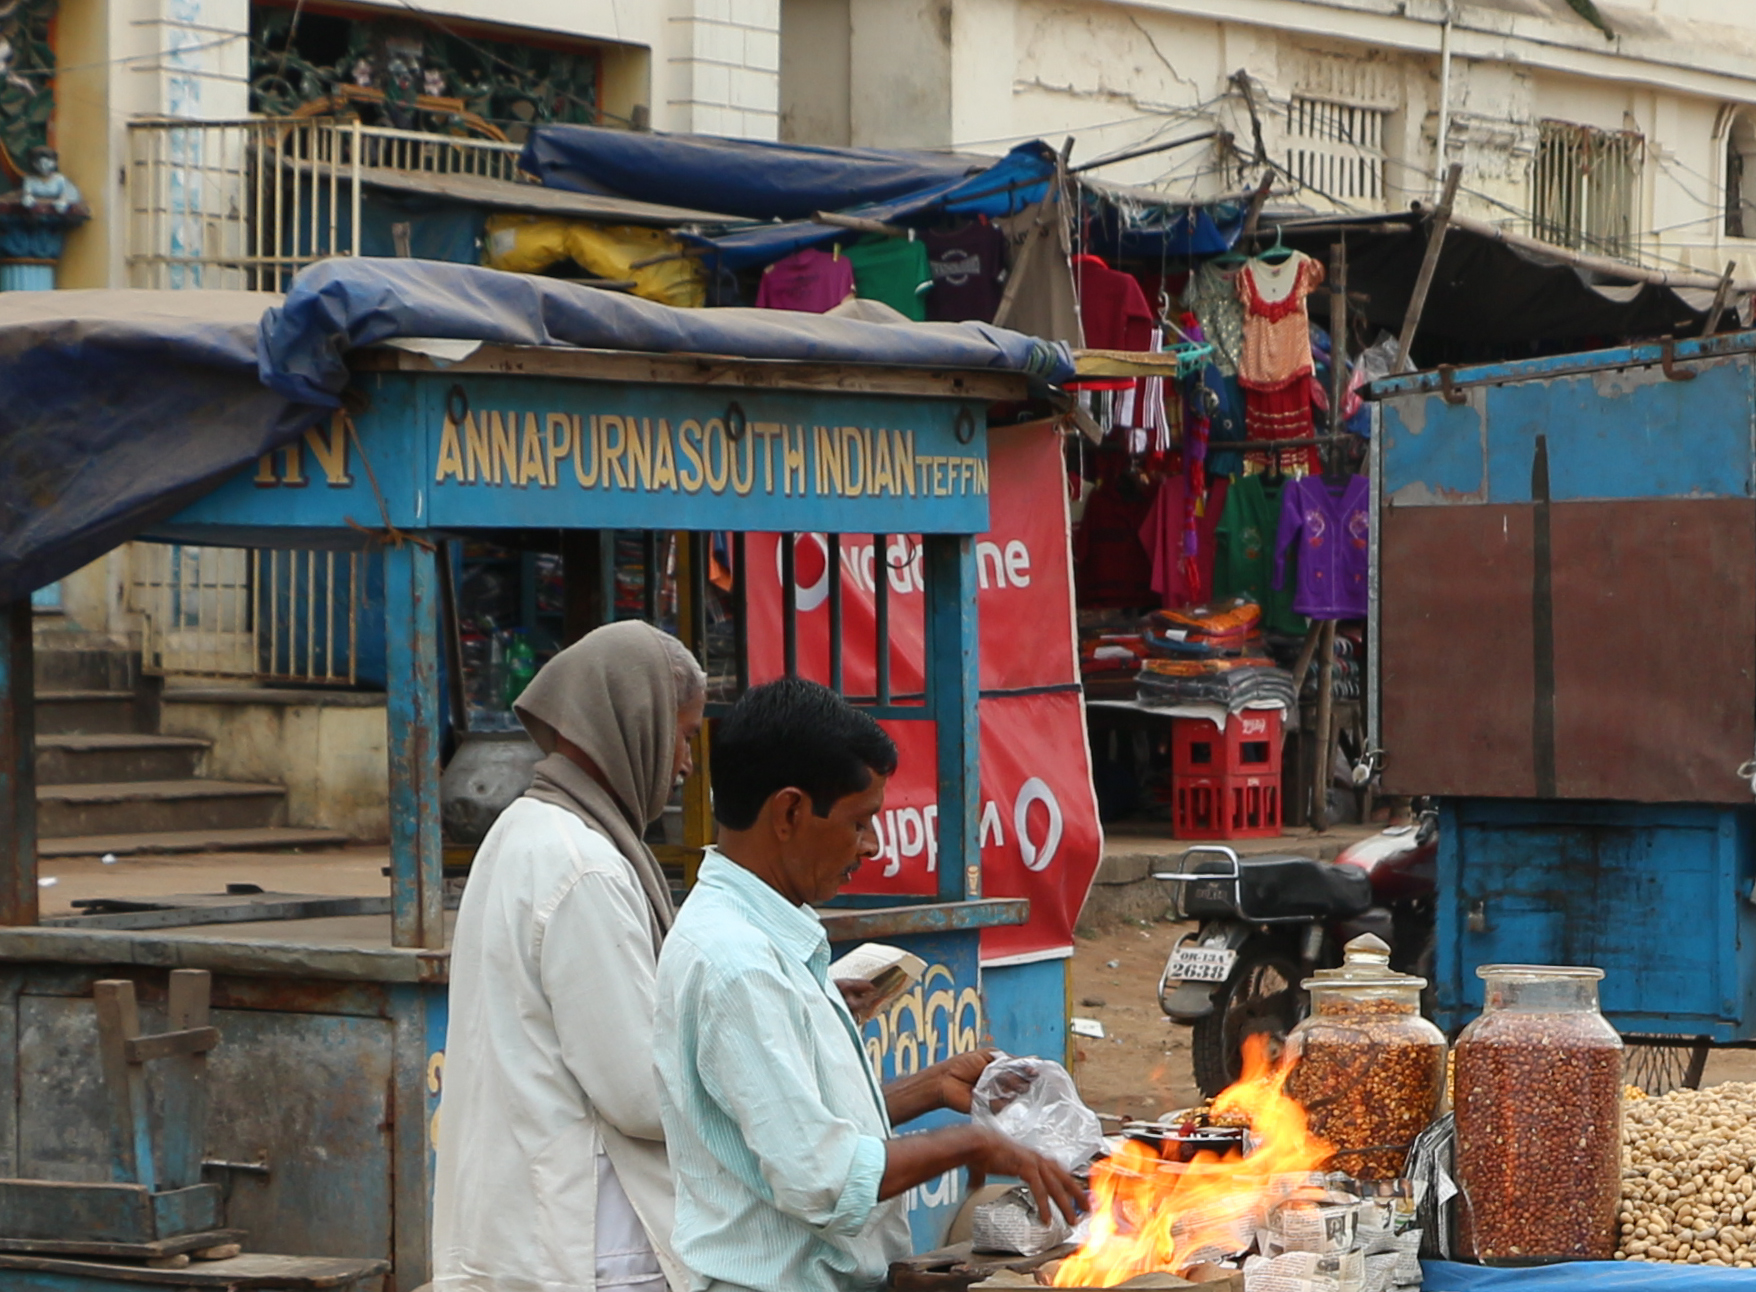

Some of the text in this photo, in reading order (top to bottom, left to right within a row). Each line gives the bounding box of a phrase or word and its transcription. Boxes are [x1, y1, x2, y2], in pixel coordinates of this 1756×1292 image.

[435, 409, 678, 492] ANNAPURNA
[678, 418, 806, 494] SOUTH
[813, 426, 917, 497] INDIAN
[1171, 962, 1225, 980] 2638
